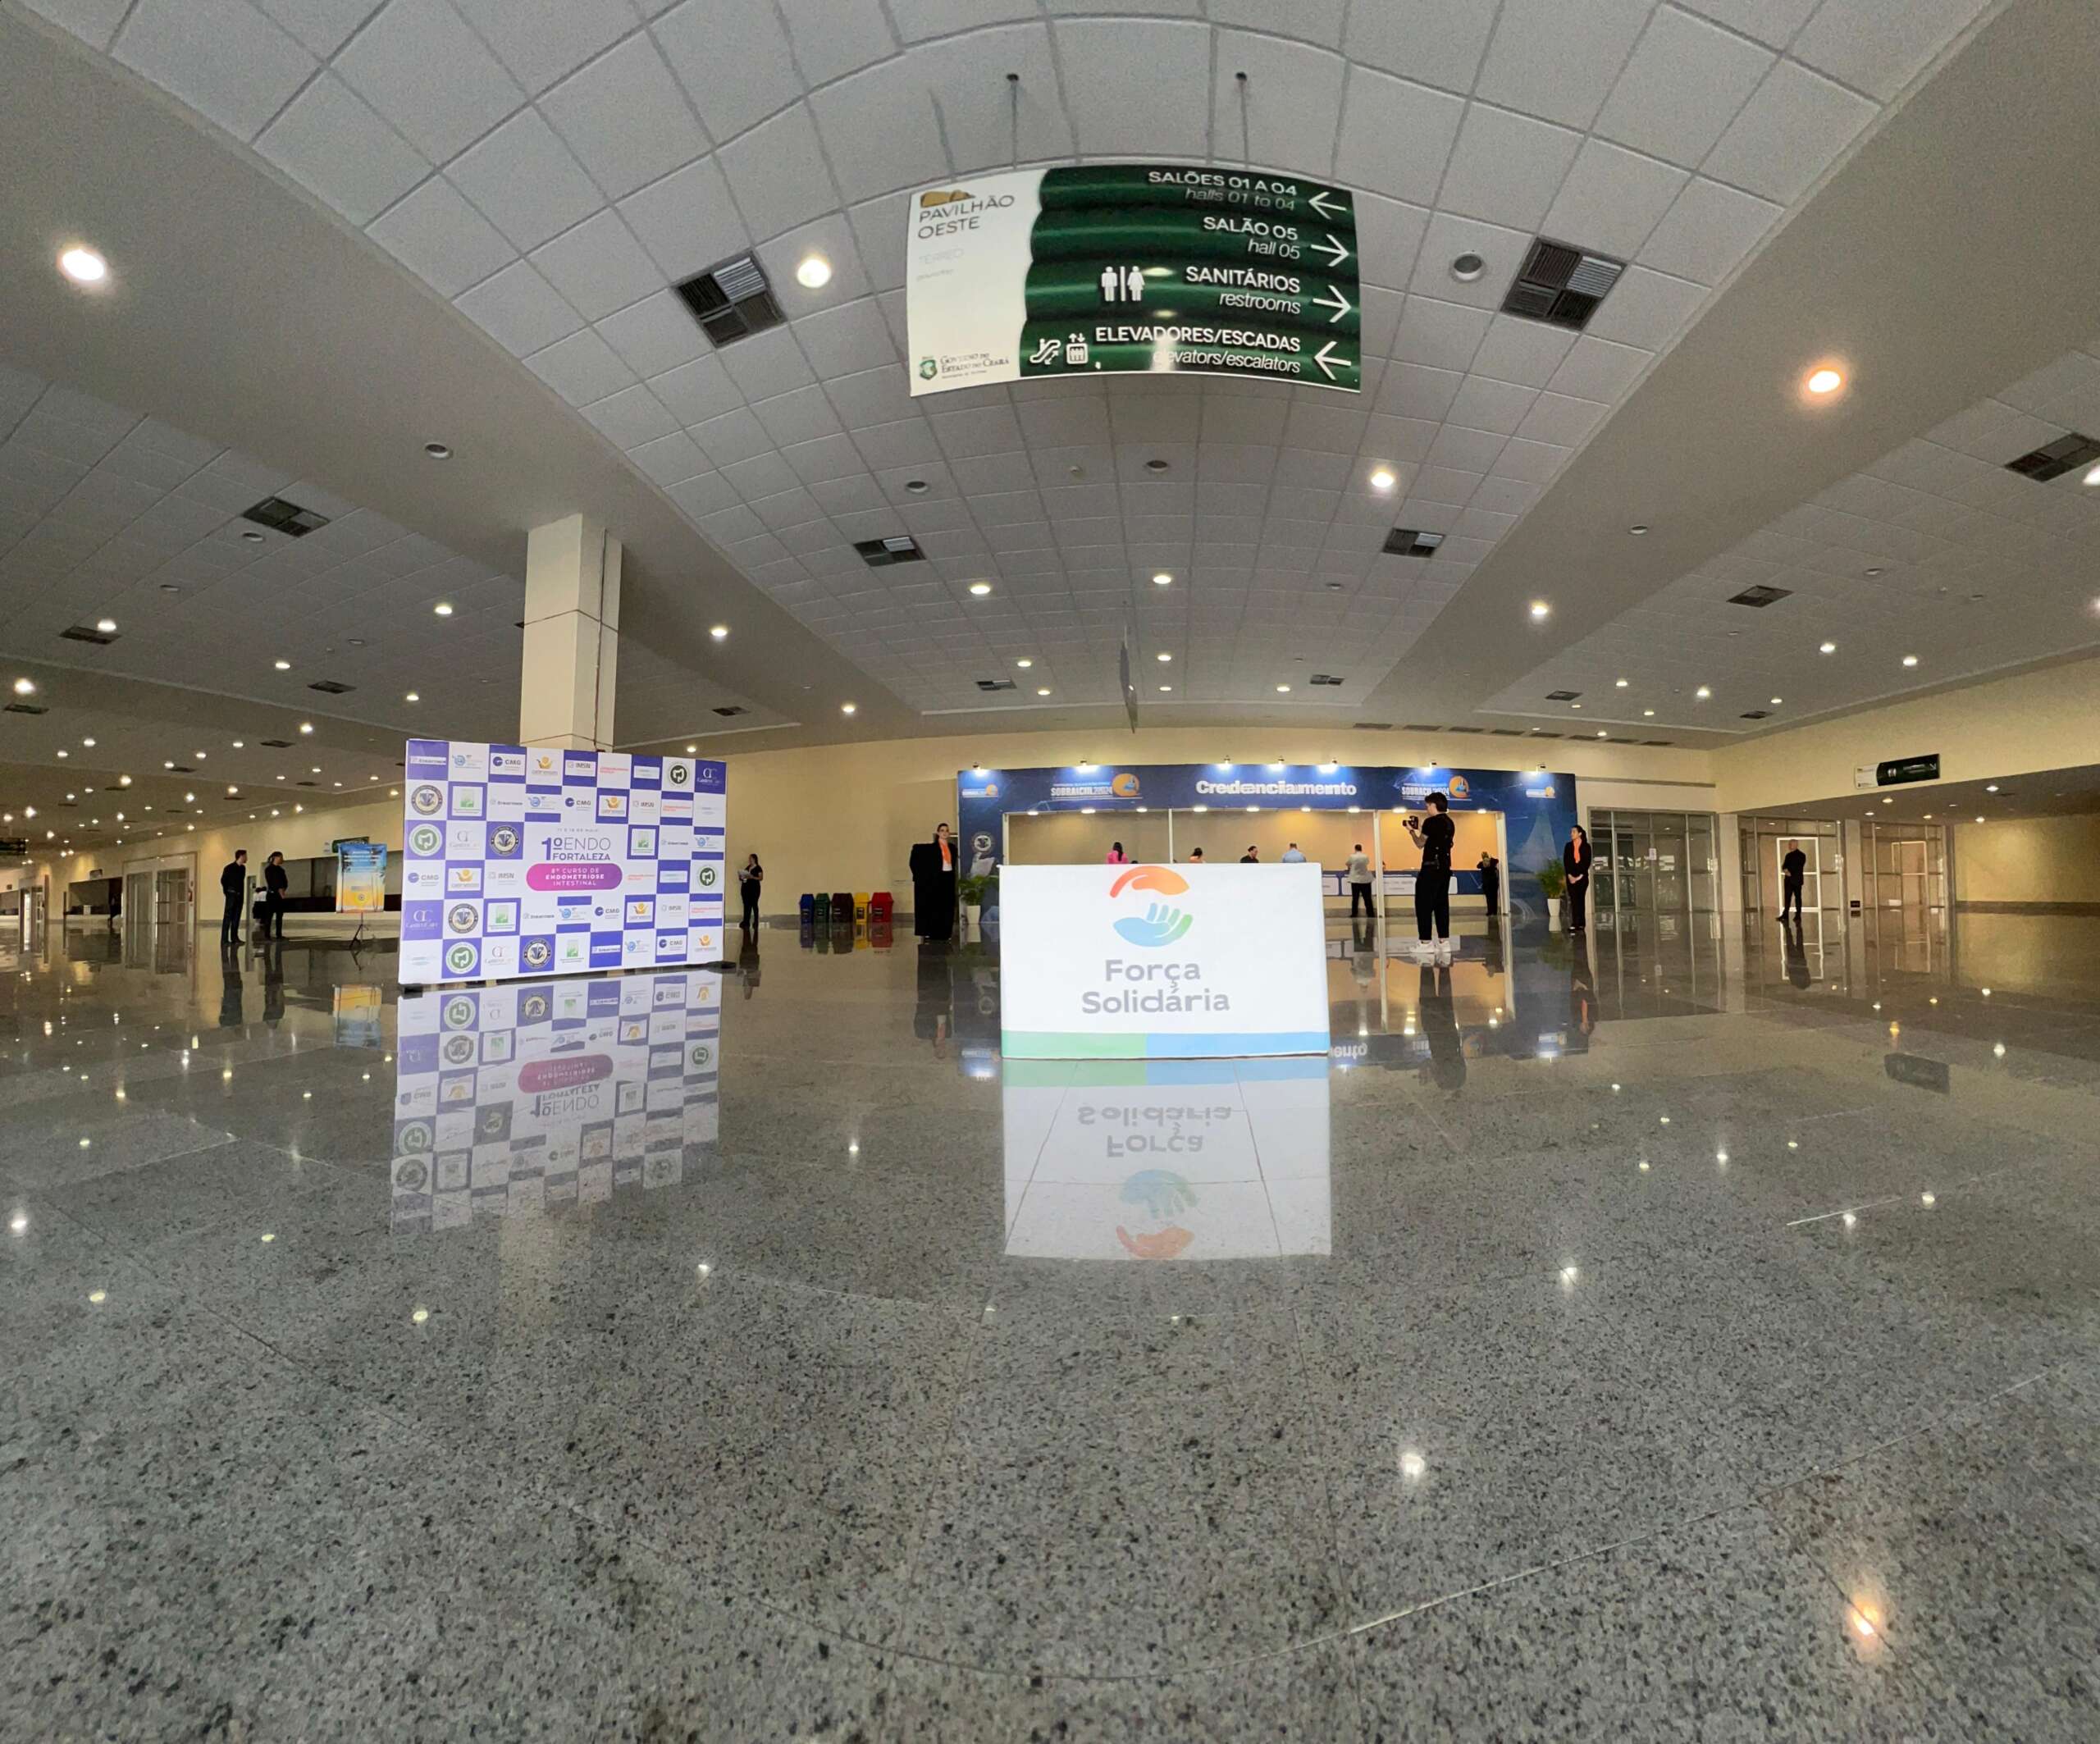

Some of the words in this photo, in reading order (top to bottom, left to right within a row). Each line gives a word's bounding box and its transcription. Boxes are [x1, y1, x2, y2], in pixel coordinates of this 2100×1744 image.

[1148, 171, 1225, 186] SALÕES
[1228, 177, 1249, 189] 01
[1255, 180, 1268, 191] A
[1271, 182, 1297, 196] 04
[919, 195, 1015, 223] PAVILHÃO
[1185, 188, 1224, 202] halls
[1228, 191, 1248, 203] 01
[1254, 194, 1271, 207] to
[1275, 198, 1295, 211] 04
[918, 216, 980, 239] OESTE
[1203, 217, 1269, 235] SALÃO
[1272, 226, 1298, 240] 05
[1248, 239, 1276, 255] hall
[1279, 244, 1300, 259] 05
[1186, 266, 1300, 294] SANITÁRIOS
[1219, 293, 1301, 314] restrooms
[1095, 326, 1300, 352] ELEVADORES/ESCADAS
[1153, 350, 1300, 373] eevators/escalators
[1195, 780, 1357, 796] Credenciamento
[564, 837, 611, 851] ENDO
[1105, 959, 1201, 988] Força
[1081, 988, 1230, 1014] Solidária
